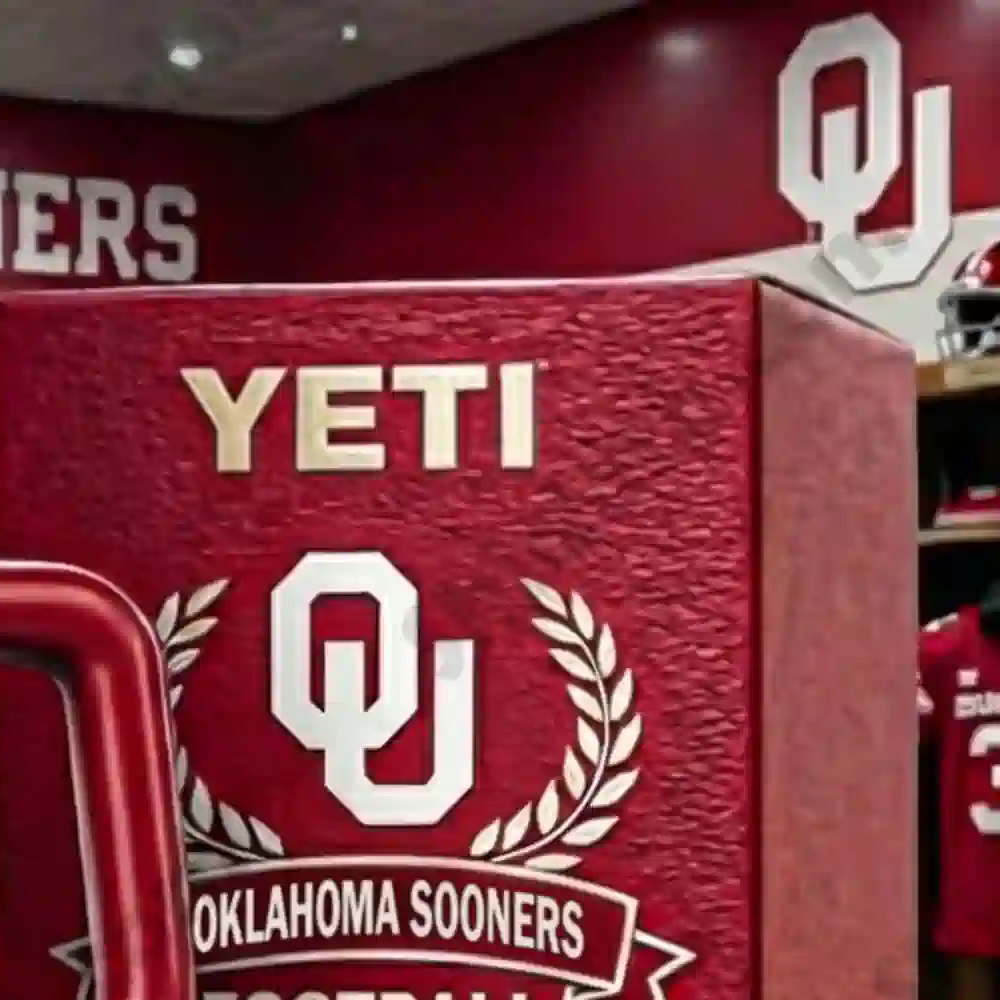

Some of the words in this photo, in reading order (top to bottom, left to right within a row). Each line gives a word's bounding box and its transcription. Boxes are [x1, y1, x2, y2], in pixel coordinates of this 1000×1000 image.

[778, 12, 951, 294] OU
[179, 362, 535, 472] YETI
[270, 551, 475, 827] OU
[193, 879, 400, 953] OKLAHOMA
[408, 880, 586, 959] SOONERS
